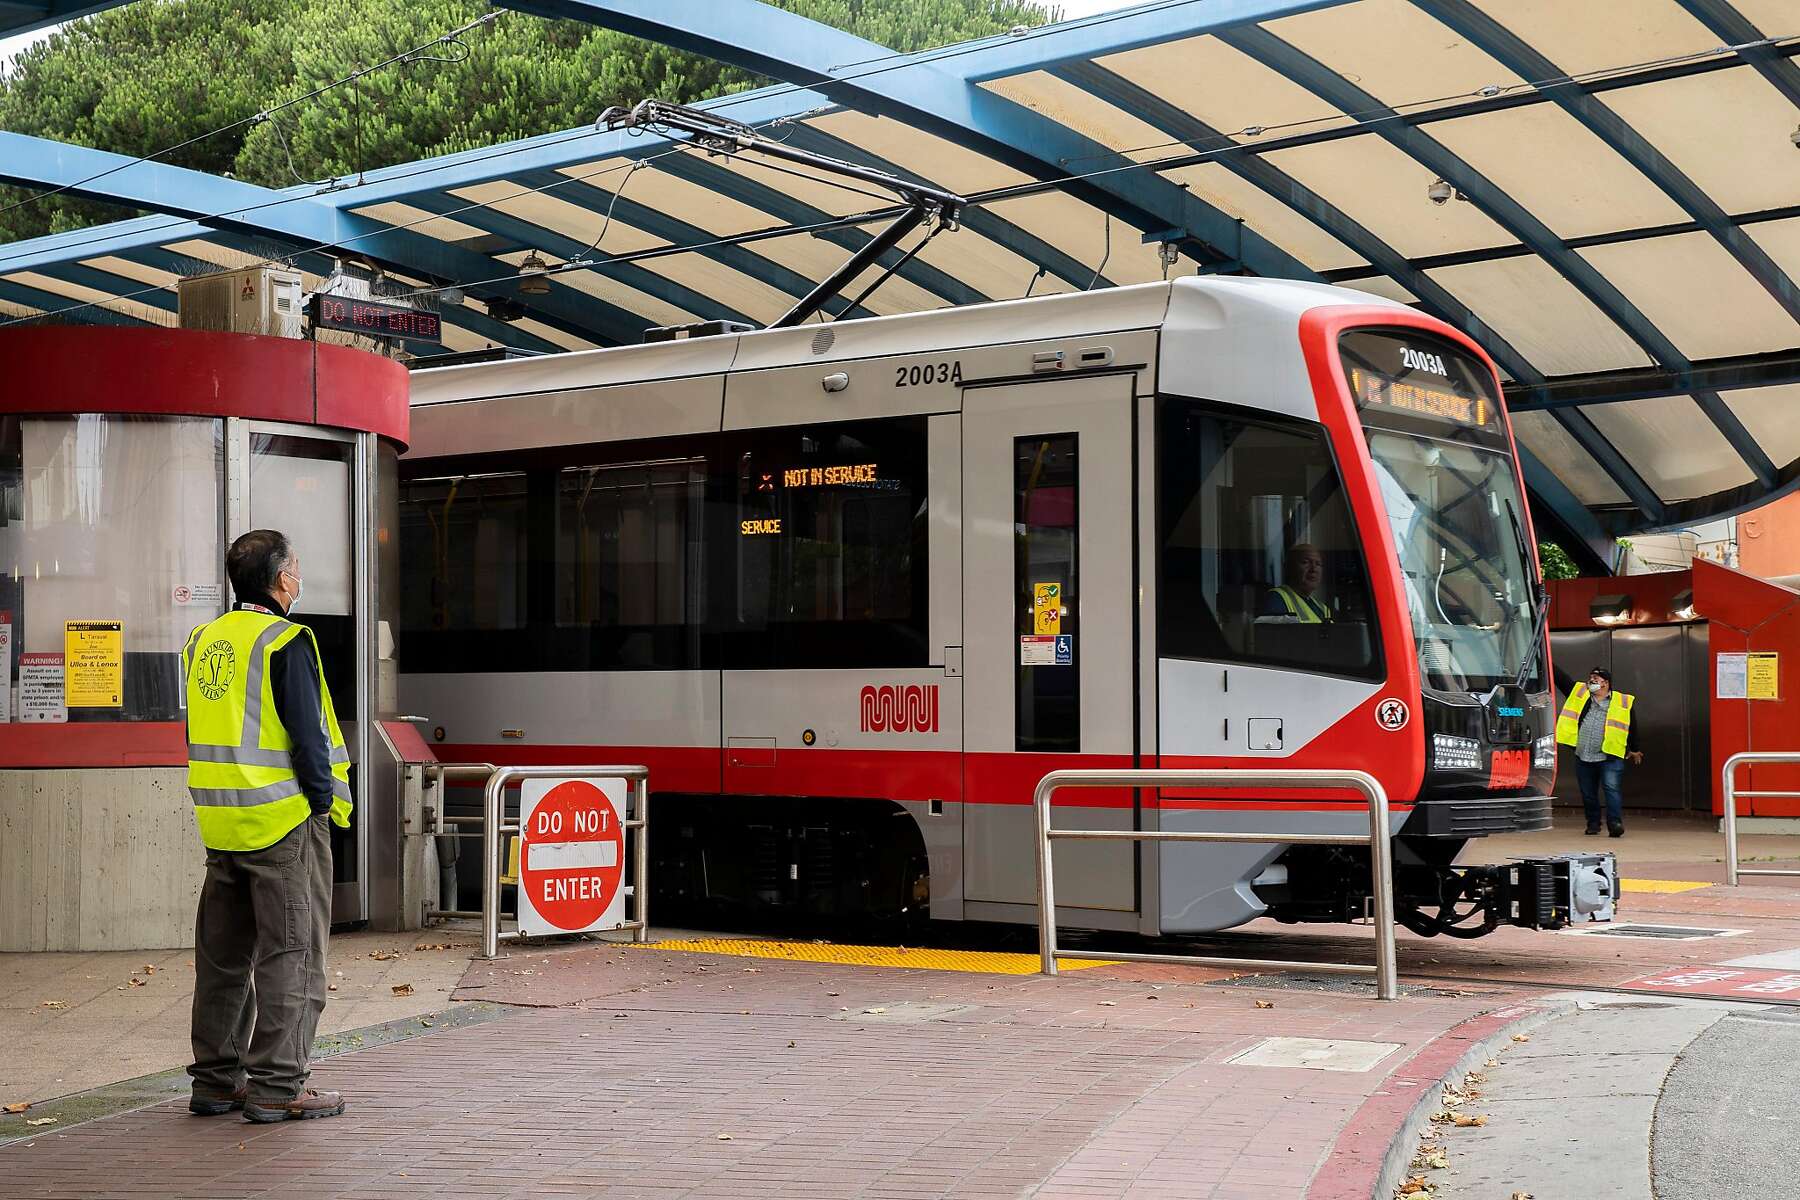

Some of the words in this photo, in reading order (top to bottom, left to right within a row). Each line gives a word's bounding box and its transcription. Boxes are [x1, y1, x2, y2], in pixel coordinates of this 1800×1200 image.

[322, 300, 345, 322] DO
[352, 303, 384, 327] NOT
[388, 310, 438, 336] ENTER
[896, 361, 962, 387] 2003A
[1399, 347, 1448, 377] 2003A
[784, 469, 808, 487] NOT
[811, 468, 822, 485] IN
[824, 464, 877, 484] SERVICE
[741, 519, 782, 534] SERVICE
[200, 640, 235, 663] MUNICIPAL
[198, 678, 229, 699] RAILWAY
[1498, 707, 1524, 717] SIEMENS
[538, 811, 563, 834] DO
[574, 809, 610, 833] NOT
[543, 876, 602, 902] ENTER
